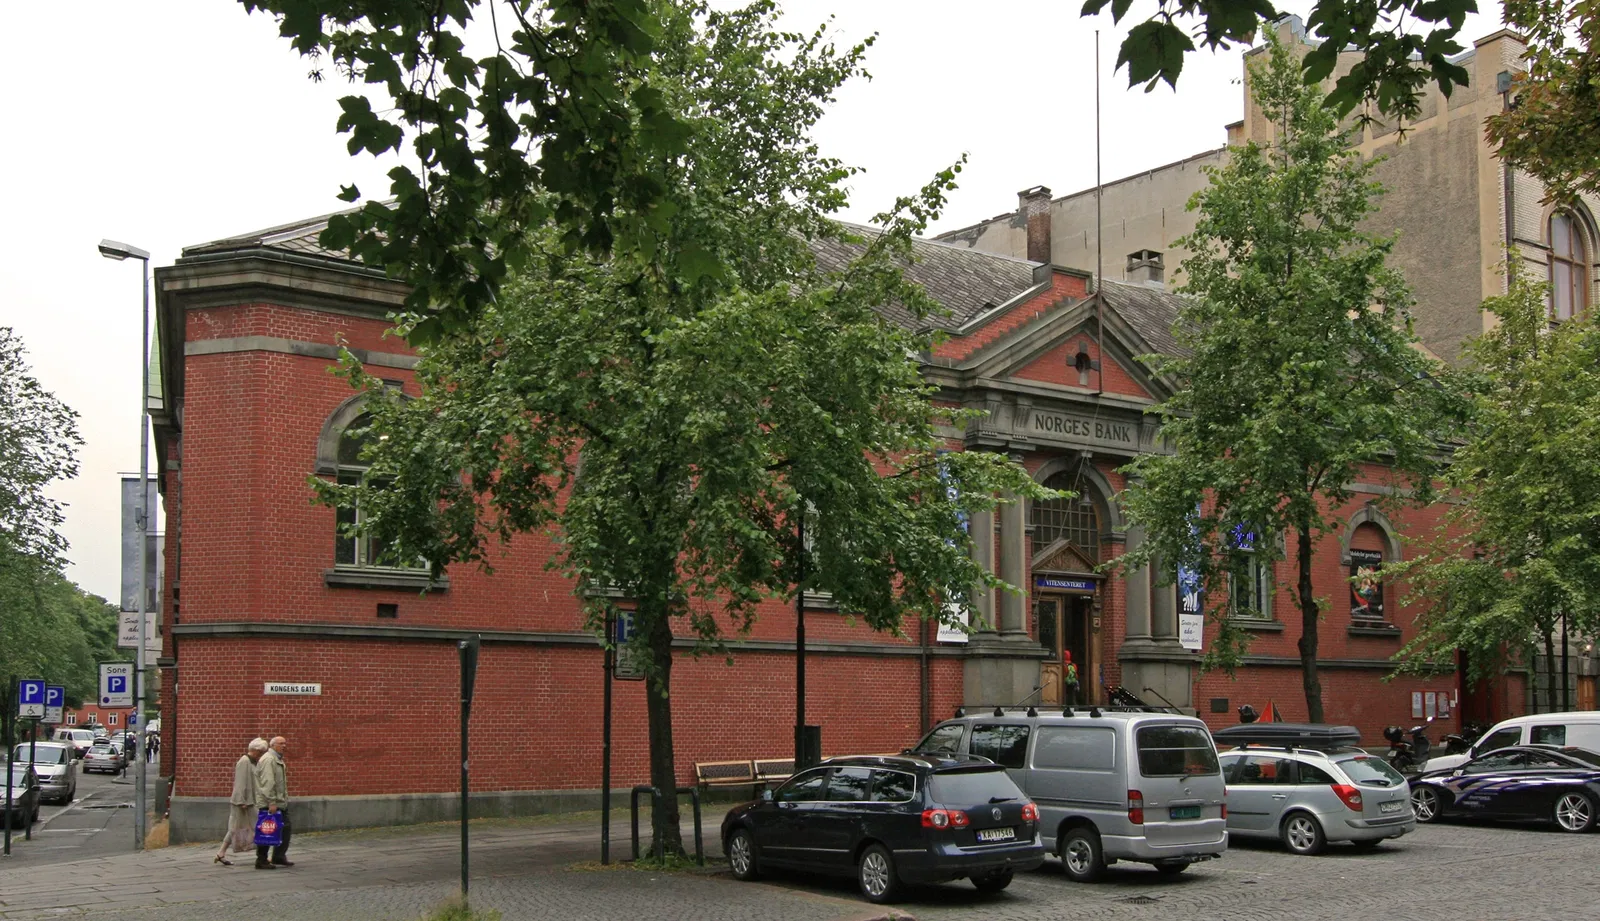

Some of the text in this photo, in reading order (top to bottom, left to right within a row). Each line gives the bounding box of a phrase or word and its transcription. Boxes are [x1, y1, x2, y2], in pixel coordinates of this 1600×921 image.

[1035, 414, 1130, 442] NORGES BANK
[1045, 580, 1086, 588] VITENSENTERET
[111, 678, 121, 691] P
[26, 684, 38, 701] P
[47, 690, 58, 704] P
